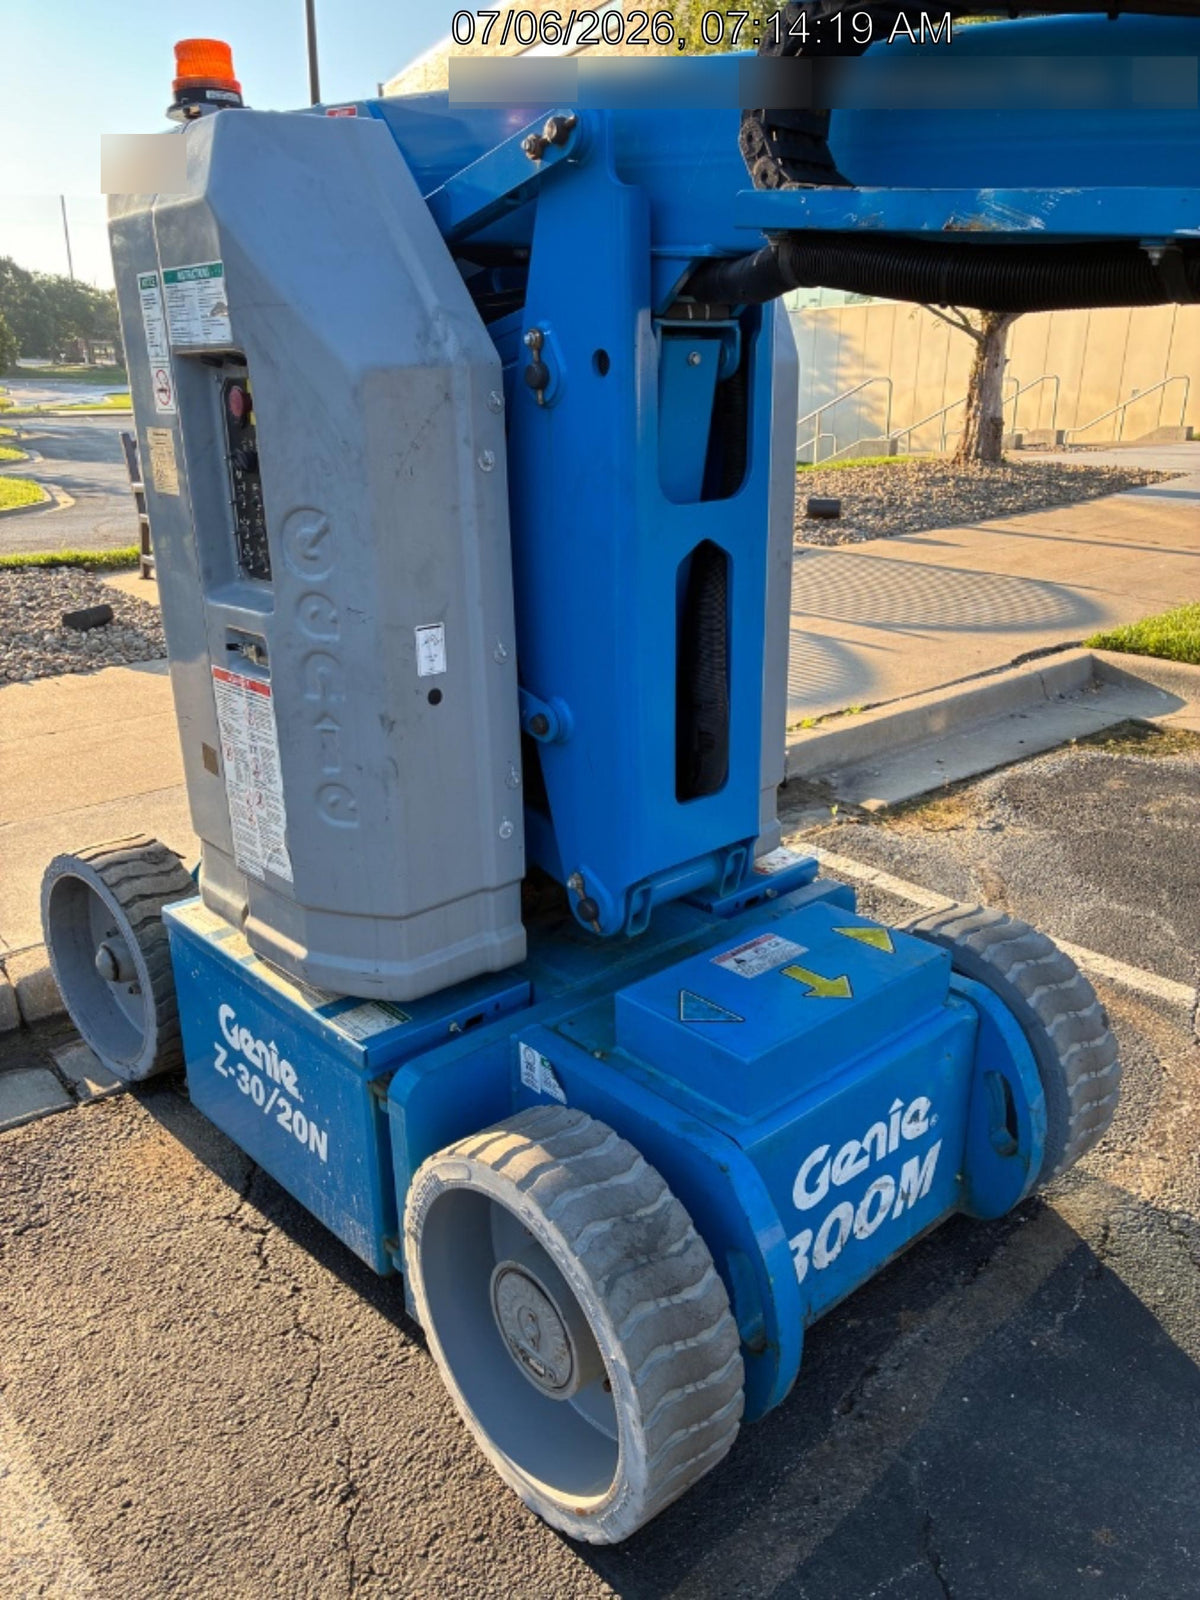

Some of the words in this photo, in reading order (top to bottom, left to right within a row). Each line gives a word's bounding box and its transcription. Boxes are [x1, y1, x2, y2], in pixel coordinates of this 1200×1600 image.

[213, 1041, 328, 1163] Z-30/20N
[218, 1003, 302, 1101] Genie
[792, 1096, 932, 1211] Genie
